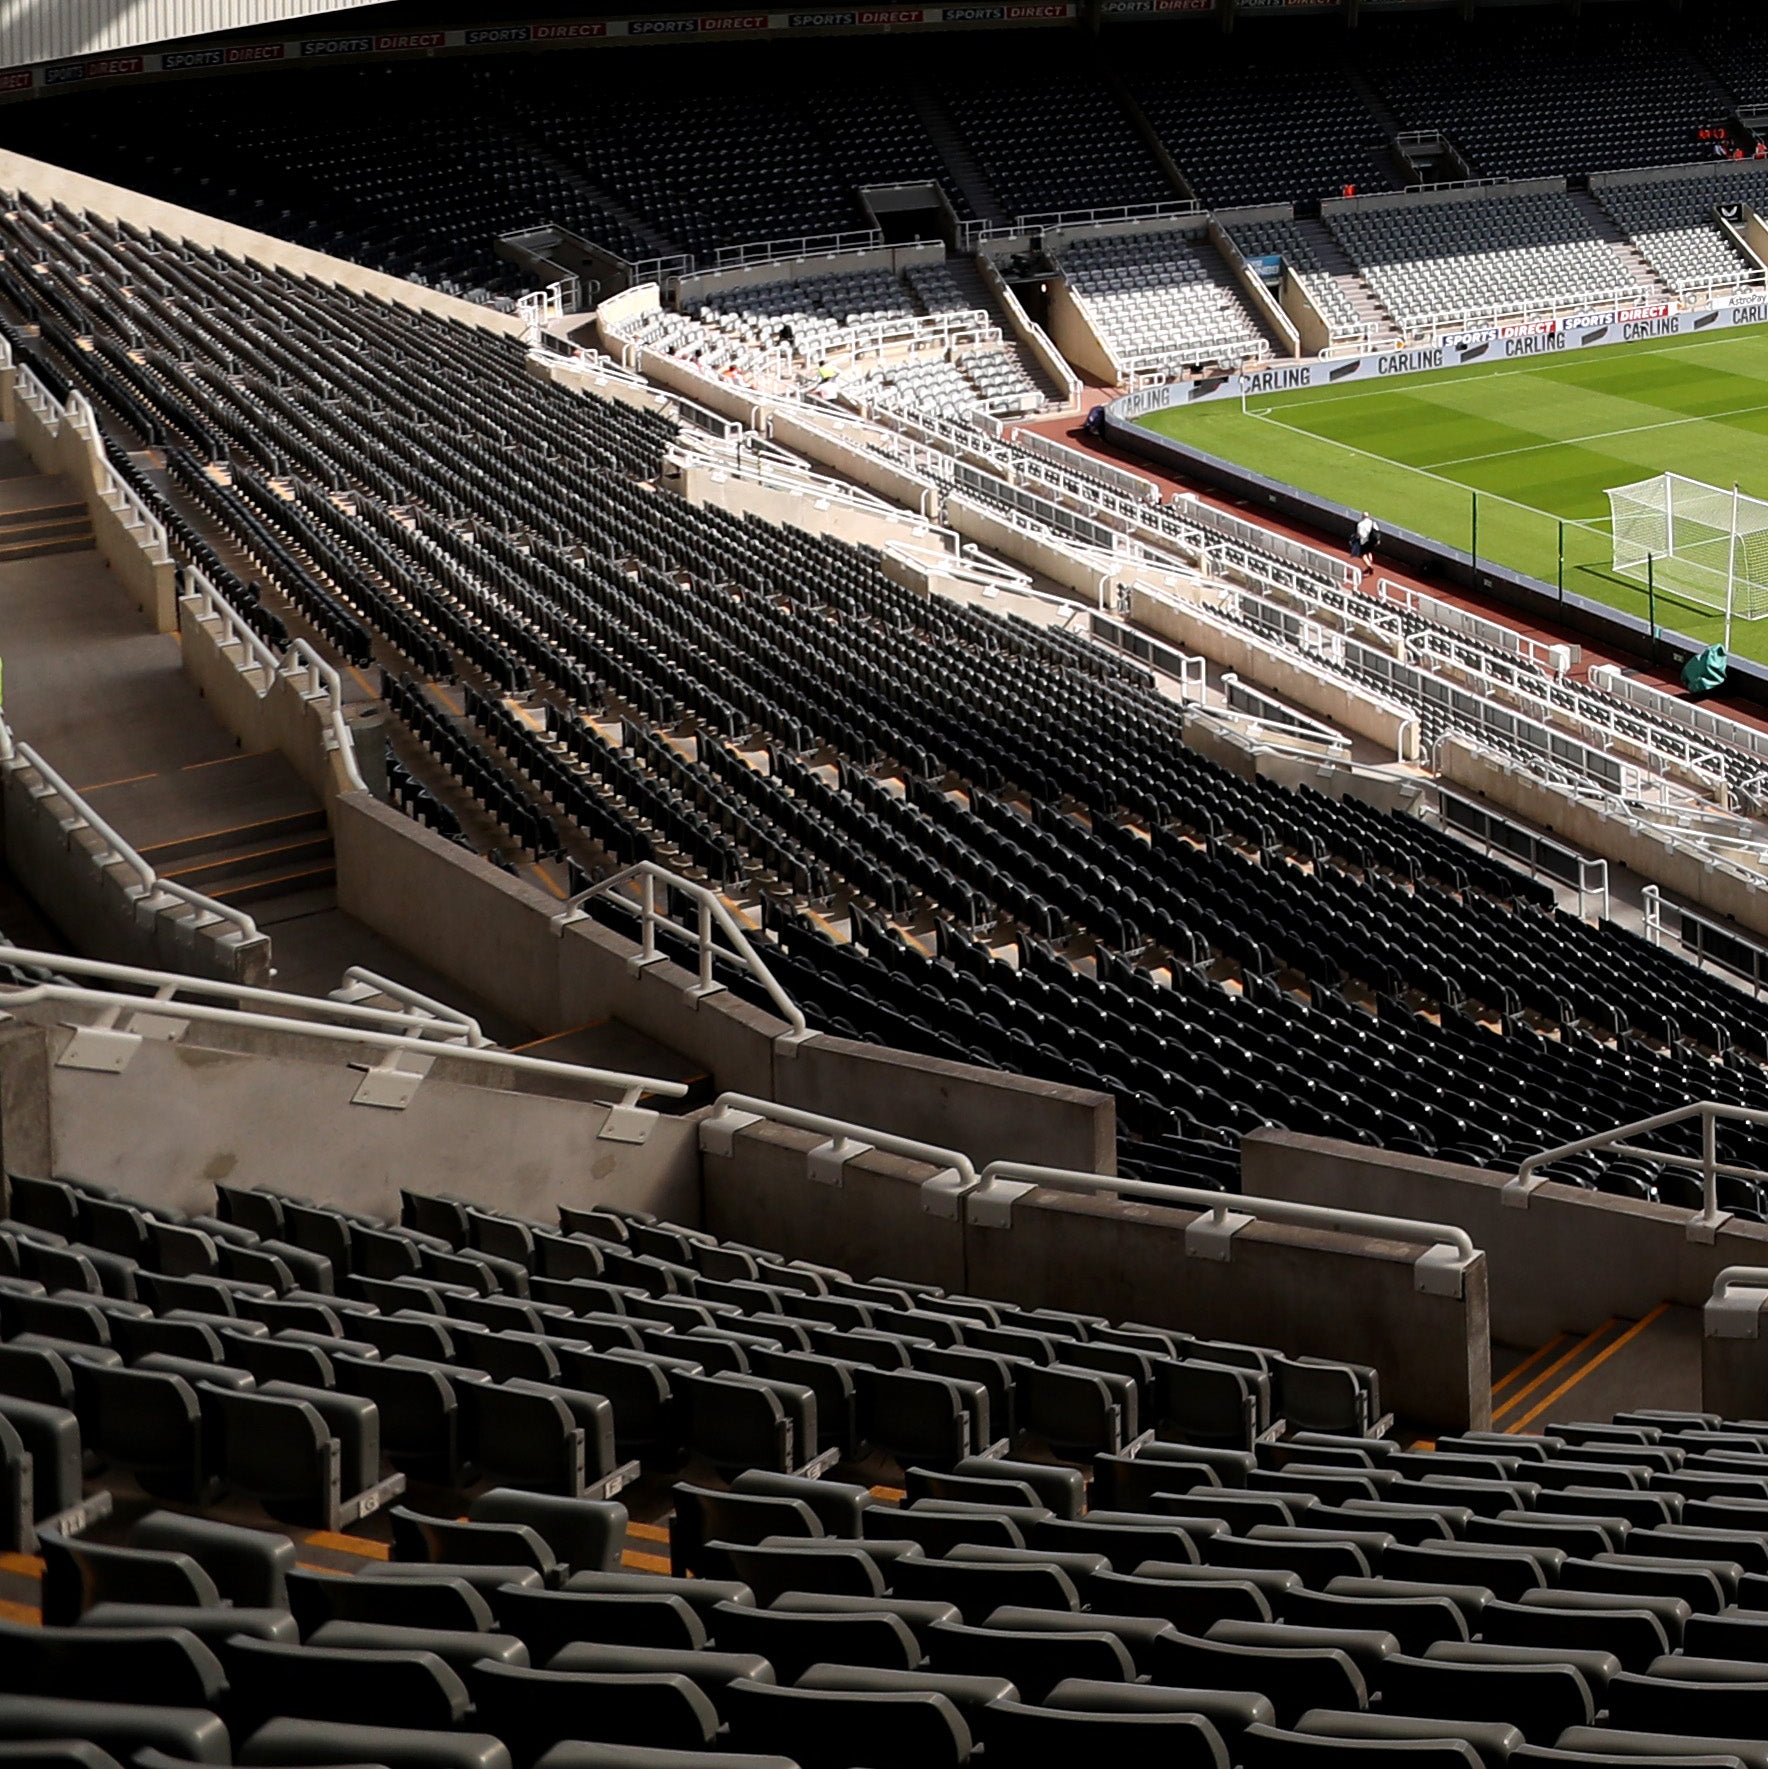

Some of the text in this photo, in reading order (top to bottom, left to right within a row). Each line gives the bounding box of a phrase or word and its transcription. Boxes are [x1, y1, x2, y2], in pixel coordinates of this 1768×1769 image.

[791, 11, 921, 27] SPORTS DIRECT
[945, 5, 1064, 20] SPORTS DIRECT
[468, 24, 602, 43] SPORTS DIRECT
[632, 17, 765, 34] SPORTS DIRECT
[304, 33, 440, 55] SPORTS DIRECT
[165, 44, 282, 68] SPORTS DIRECT
[1728, 293, 1767, 307] AstroPay
[1564, 306, 1668, 329] SPORTS DIRECT
[1623, 316, 1680, 340] CARLING
[1443, 321, 1554, 346] SPORTS DIRECT
[1505, 332, 1566, 356] CARLING
[1377, 349, 1443, 374] CARLING
[1242, 367, 1311, 394] CARLING
